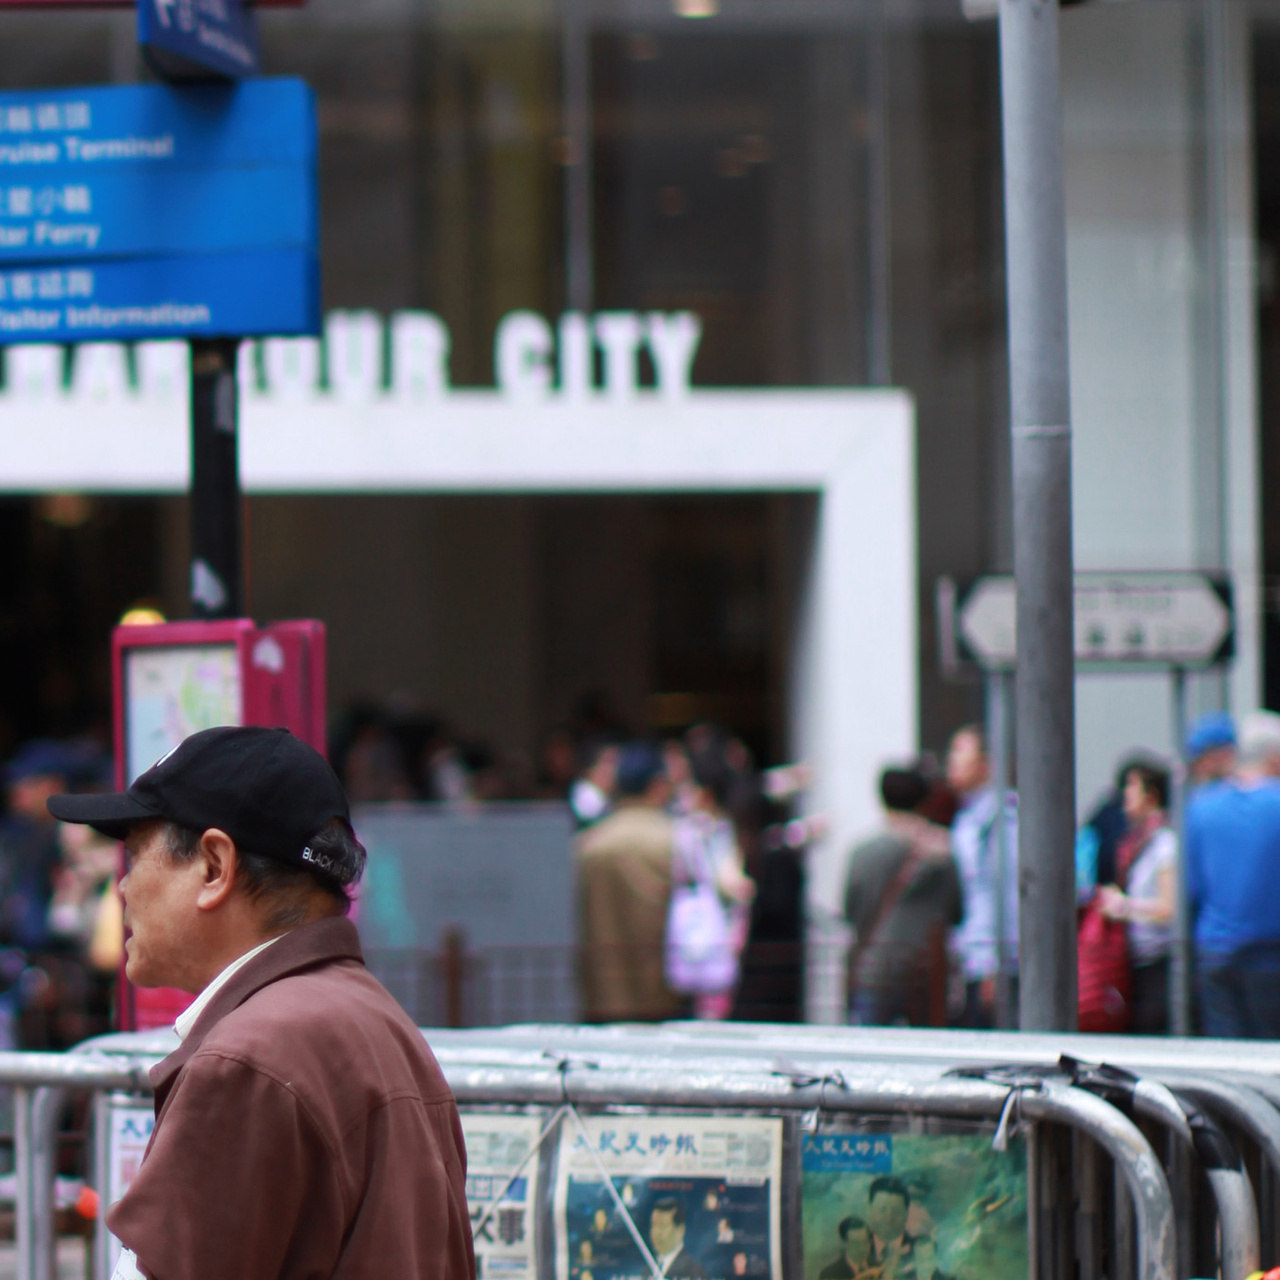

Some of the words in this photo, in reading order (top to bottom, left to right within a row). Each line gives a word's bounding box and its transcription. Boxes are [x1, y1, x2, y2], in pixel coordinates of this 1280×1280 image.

[65, 134, 174, 161] Terminal
[34, 220, 101, 250] Ferry
[66, 302, 211, 329] Information
[495, 310, 703, 390] CITY
